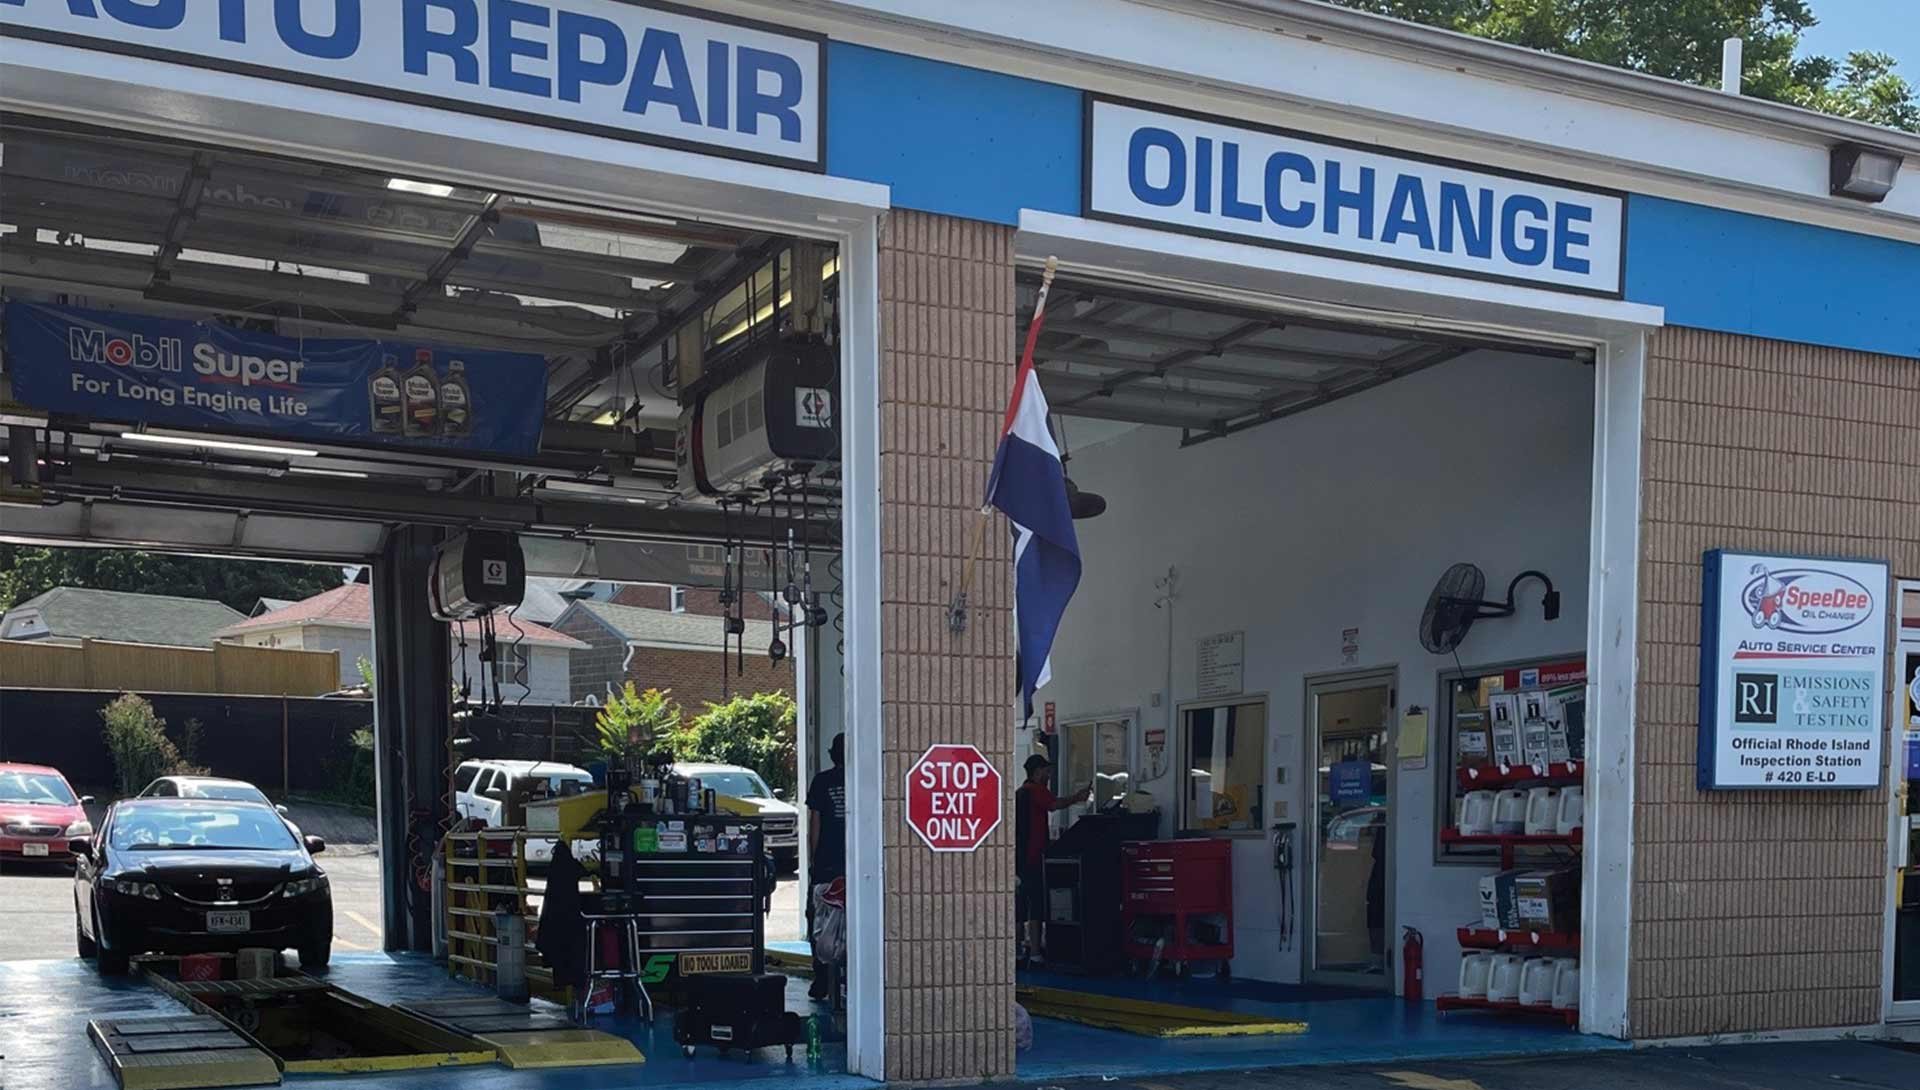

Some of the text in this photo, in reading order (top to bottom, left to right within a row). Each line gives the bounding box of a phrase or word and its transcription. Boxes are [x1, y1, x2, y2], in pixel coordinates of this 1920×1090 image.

[402, 0, 802, 143] REPAIR
[1127, 126, 1593, 275] OILCHANGE
[69, 327, 304, 387] Mobil Super
[71, 372, 308, 417] For Long Engine Life
[1786, 585, 1868, 610] SpeeDee
[1801, 609, 1856, 621] OIL CHANGE
[1737, 639, 1876, 656] AUTO SERVICE CENTER
[1782, 675, 1871, 691] EMISSIONS
[1739, 681, 1776, 715] RI
[1812, 695, 1870, 709] SAFETY
[1795, 713, 1869, 728] TESTING
[1732, 737, 1871, 751] Official Rhode Island
[1740, 754, 1862, 769] Inspection Station
[920, 760, 989, 790] STOP
[1765, 771, 1836, 783] # 420 E-LD
[931, 791, 977, 815] EXIT
[926, 816, 982, 841] ONLY
[683, 954, 749, 972] NO TOOLS LOANED
